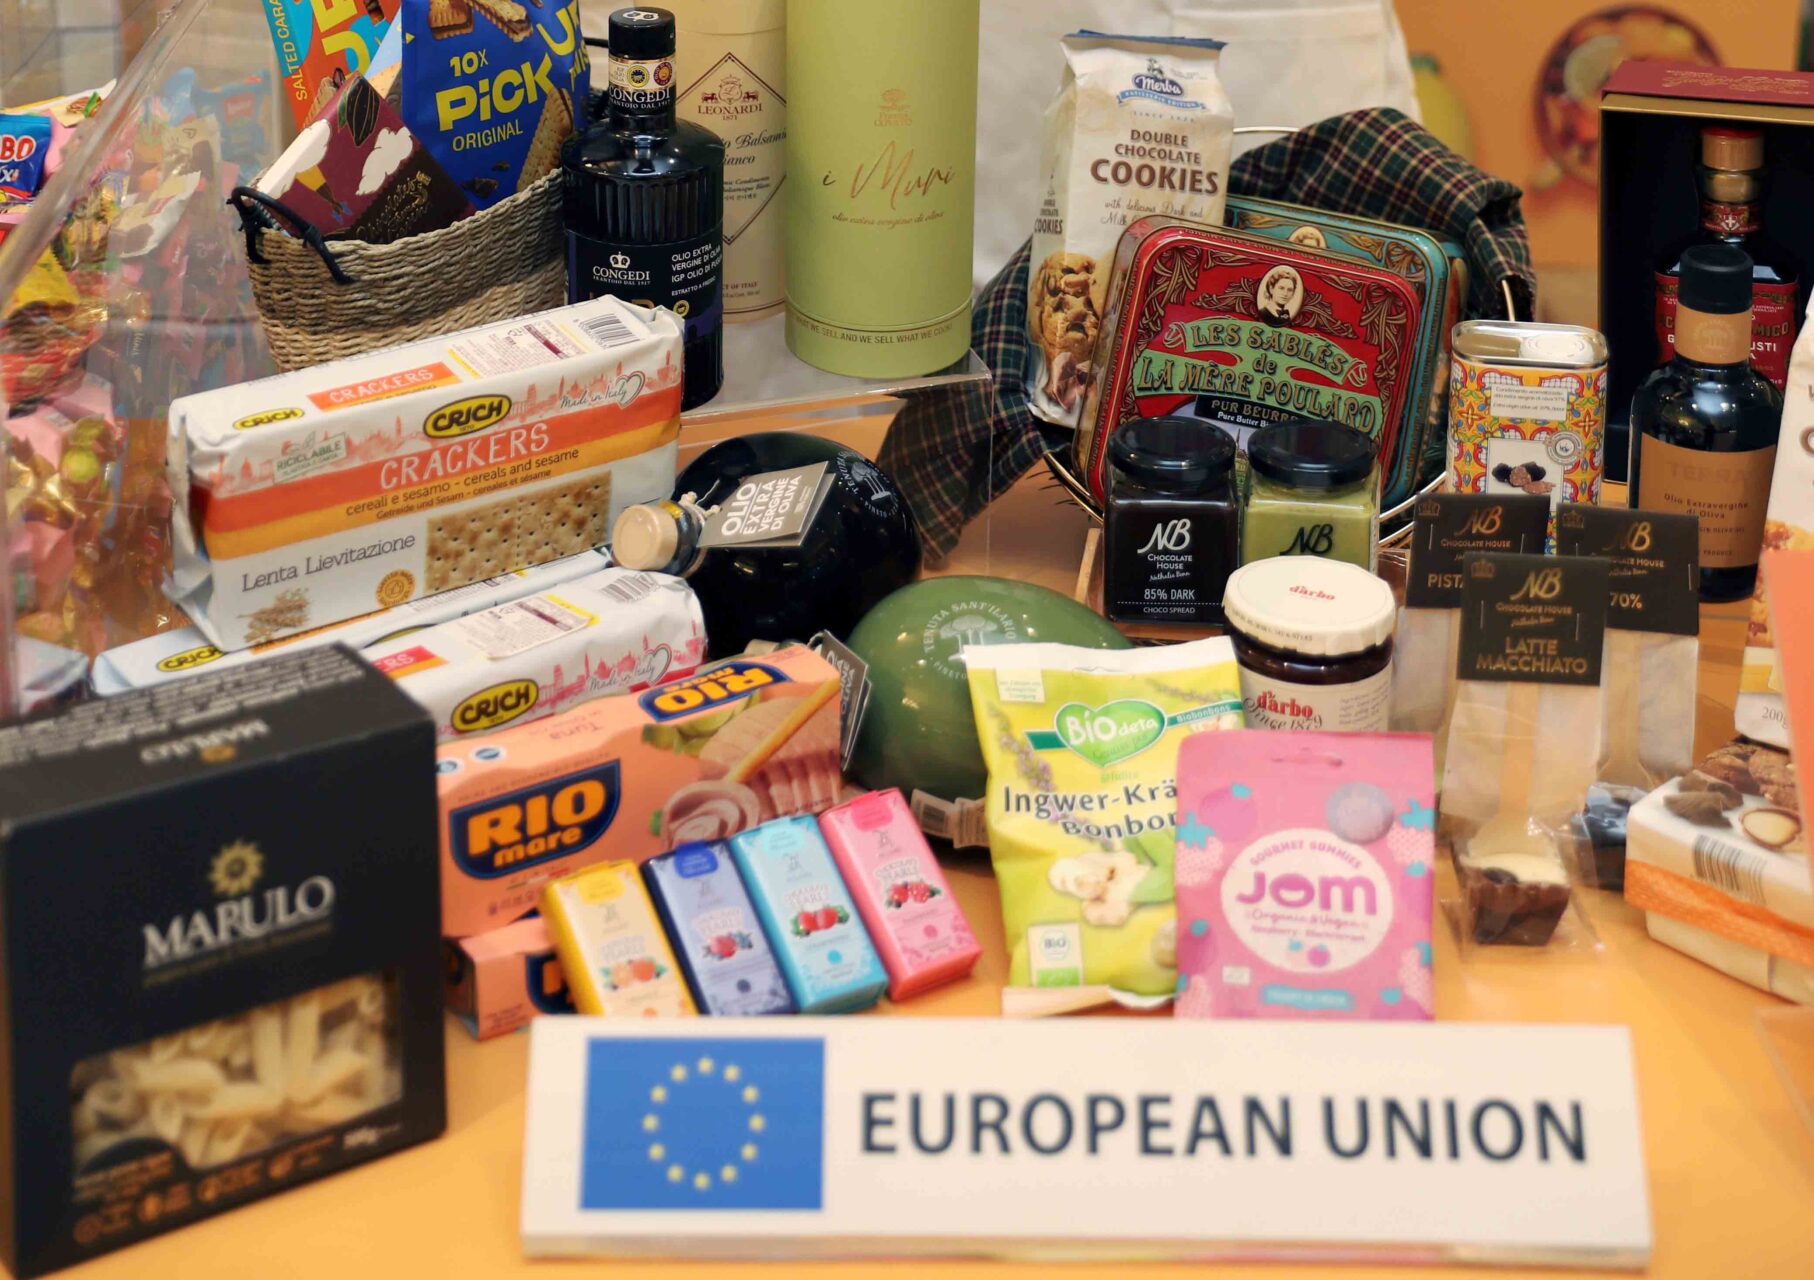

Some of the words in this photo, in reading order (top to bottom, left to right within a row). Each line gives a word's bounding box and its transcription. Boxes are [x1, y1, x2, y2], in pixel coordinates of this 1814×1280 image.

[282, 41, 308, 101] SALTED
[609, 86, 670, 103] CONGEDI
[1135, 76, 1181, 94] Merba
[698, 103, 763, 115] LEONARDI
[452, 119, 523, 152] ORIGINAL
[1130, 129, 1189, 147] DOUBLE
[1115, 144, 1202, 165] CHOCOLATE
[1090, 158, 1220, 195] COOKIES
[1105, 199, 1122, 209] with
[1126, 201, 1157, 213] delicious
[1161, 203, 1185, 217] Dark
[1190, 205, 1203, 218] and
[672, 251, 691, 262] OLIO
[692, 243, 712, 256] EXTRA
[672, 258, 701, 271] VERGINE
[703, 254, 710, 262] DI
[592, 265, 650, 280] CONGEDI
[672, 272, 685, 283] IGP
[687, 267, 704, 278] OLIO
[705, 264, 711, 272] DI
[671, 285, 698, 296] ESTRATTO
[840, 333, 858, 342] AND
[897, 334, 919, 343] WHAT
[921, 330, 933, 339] WE
[1192, 324, 1242, 348] LES
[1248, 325, 1346, 377] SABLÉS
[1252, 353, 1278, 376] de
[329, 368, 433, 403] CRACKERS
[1136, 356, 1174, 392] LA
[1259, 376, 1376, 433] POULARD
[431, 398, 504, 432] CRICH
[1210, 399, 1240, 414] PUR
[240, 408, 299, 429] CRICH
[1217, 411, 1234, 421] Pure
[1236, 415, 1259, 426] Butter
[277, 441, 341, 471] RICICLABILE
[380, 422, 550, 491] CRACKERS
[345, 495, 389, 517] cereali
[391, 493, 400, 504] e
[402, 481, 451, 501] sesamo
[464, 466, 507, 487] cereals
[510, 461, 532, 475] and
[535, 448, 580, 467] sesame
[376, 506, 416, 520] Getreide
[420, 498, 434, 508] und
[435, 492, 465, 506] Sesam
[721, 481, 757, 536] OLIO
[743, 479, 777, 535] EXTRA
[758, 477, 789, 532] VERGINE
[769, 513, 782, 531] DI
[783, 475, 803, 512] OLIVA
[1664, 494, 1683, 504] Olio
[1454, 505, 1503, 536] NB
[1700, 510, 1725, 518] Oliva
[1137, 518, 1191, 554] NB
[1280, 523, 1334, 556] NB
[1441, 538, 1484, 547] CHOCOLATE
[241, 564, 299, 593] Lenta
[304, 533, 417, 574] Lievitazione
[1147, 553, 1193, 562] CHOCOLATE
[1156, 562, 1184, 570] HOUSE
[1636, 559, 1665, 568] HOUSE
[1144, 588, 1168, 601] 85%
[1170, 588, 1195, 600] DARK
[1510, 569, 1561, 601] NB
[1143, 606, 1168, 614] CHOCO
[1496, 602, 1542, 614] CHOCOLATE
[1544, 605, 1572, 616] HOUSE
[1610, 592, 1643, 609] 70%
[923, 609, 950, 654] TENUTA
[1504, 637, 1558, 656] LATTE
[1476, 654, 1588, 675] MACCHIATO
[653, 667, 774, 714] RIO
[459, 684, 530, 726] CRICH
[1176, 704, 1231, 723] Biobonbons
[1290, 715, 1322, 730] 1879
[467, 779, 606, 857] RIO
[493, 826, 582, 868] mare
[1250, 840, 1304, 865] GOURMET
[142, 875, 336, 970] MARULO
[861, 1092, 1293, 1158] EUROPEAN
[1321, 1096, 1588, 1162] UNION
